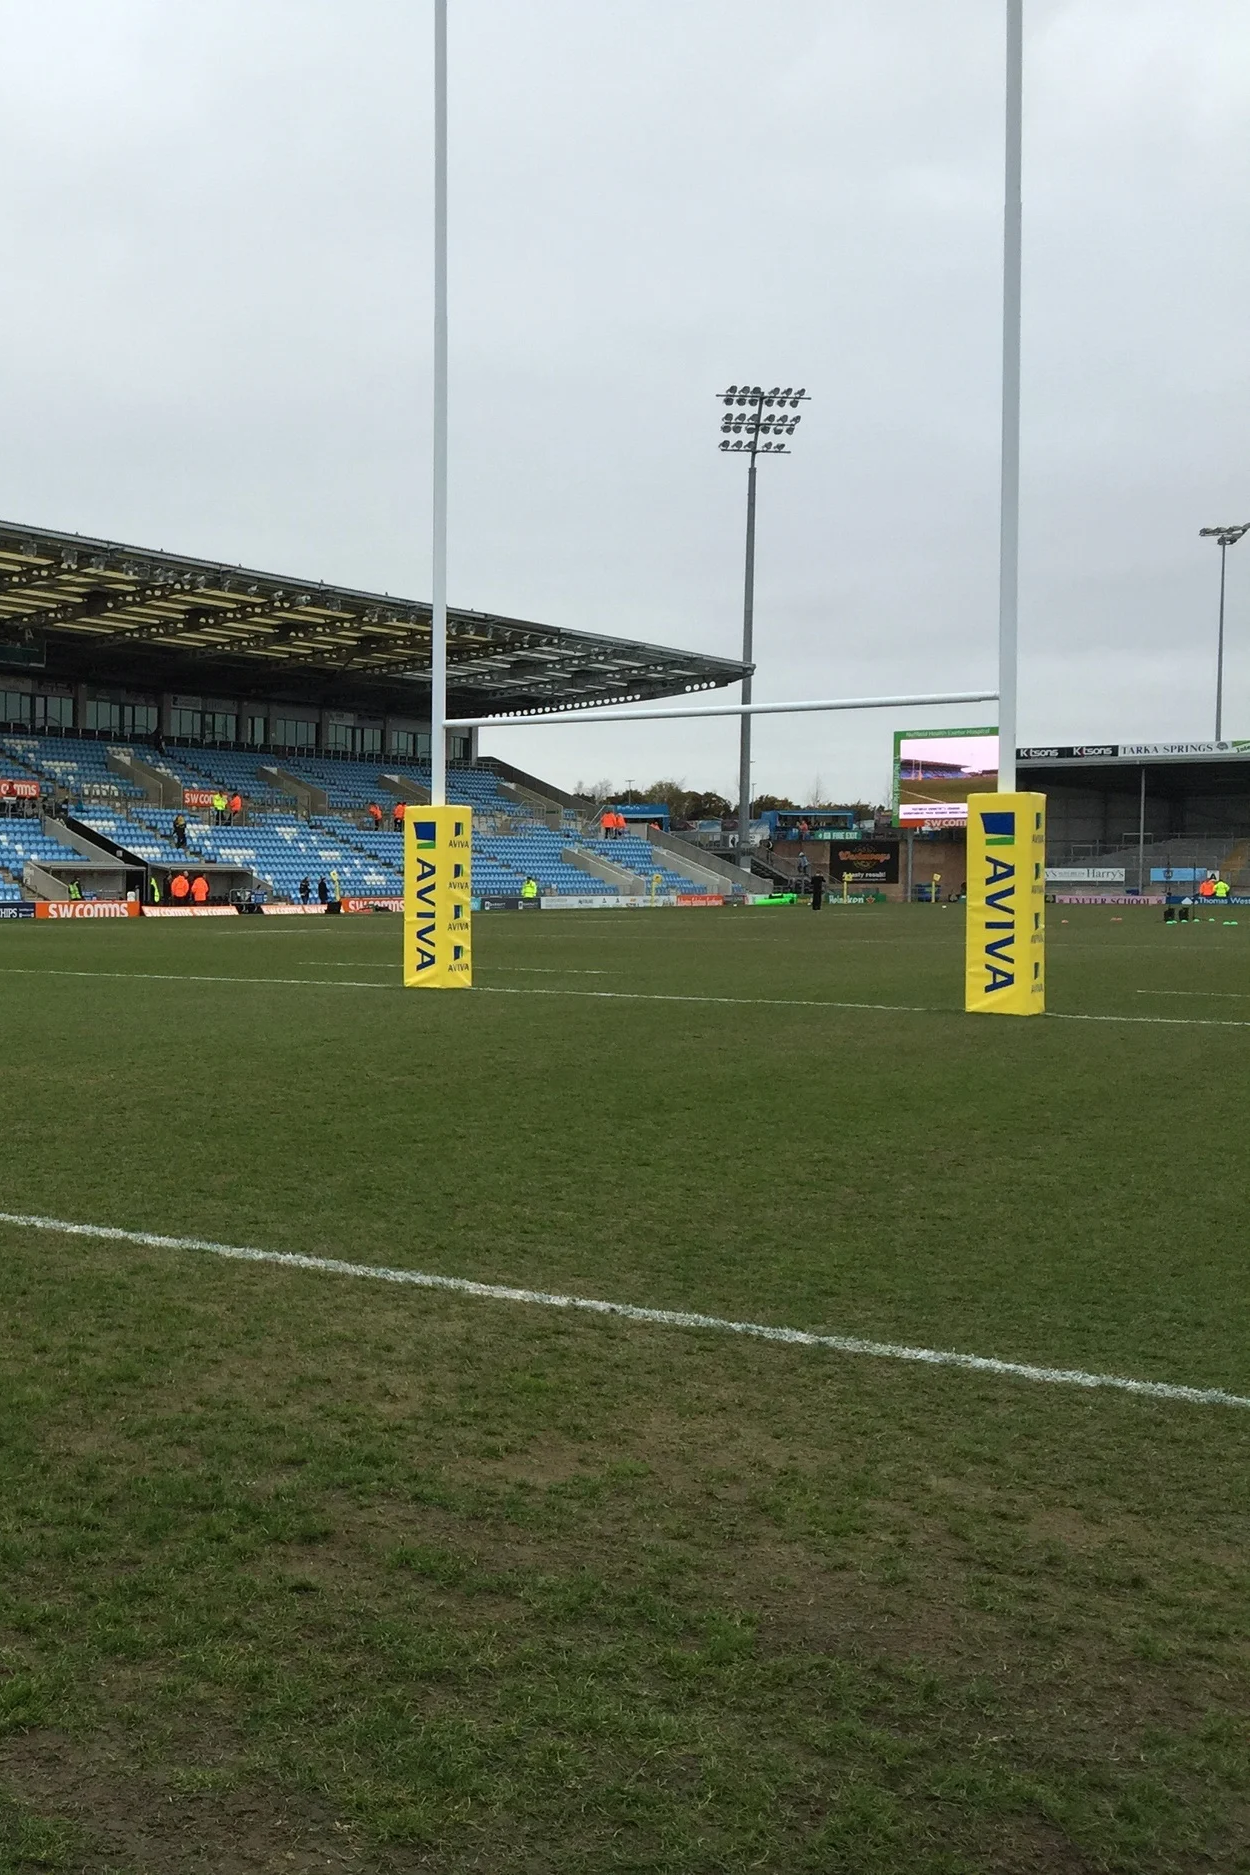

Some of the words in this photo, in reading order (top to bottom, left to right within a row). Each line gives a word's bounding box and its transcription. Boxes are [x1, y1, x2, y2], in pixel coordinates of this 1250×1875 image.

[1121, 746, 1159, 755] TARKA
[1163, 744, 1213, 753] SPRINGS
[448, 840, 470, 848] AVIVA
[1087, 869, 1124, 880] Harry's
[448, 881, 469, 890] AVIVA
[416, 857, 437, 972] AVIVA
[447, 923, 469, 931] AVIVA
[985, 855, 1015, 993] AVIVA
[448, 964, 470, 972] AVIVA
